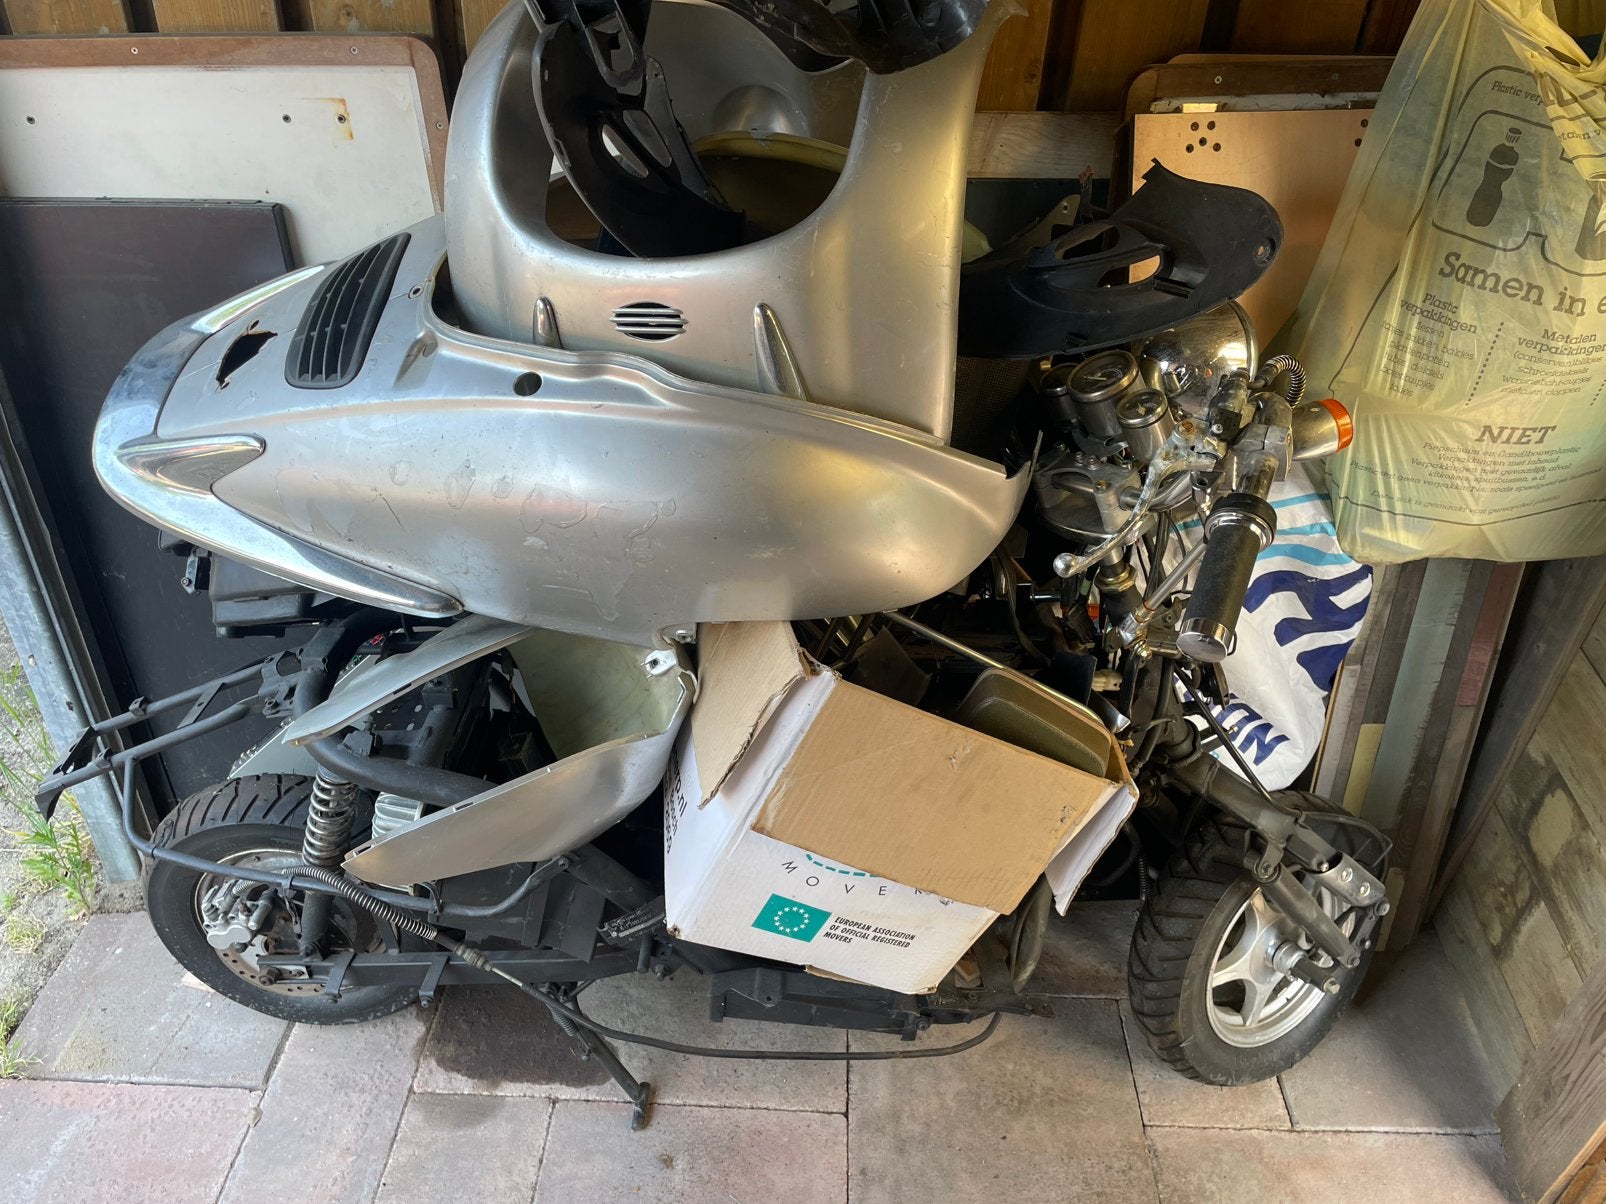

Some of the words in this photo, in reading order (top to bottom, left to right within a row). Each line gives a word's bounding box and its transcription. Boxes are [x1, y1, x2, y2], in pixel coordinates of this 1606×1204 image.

[1491, 80, 1523, 97] Plastic
[1438, 251, 1545, 307] Samen
[1552, 286, 1587, 317] in
[1422, 292, 1458, 315] Plastic
[1541, 328, 1597, 345] Metalen
[1474, 425, 1557, 446] NIET
[823, 931, 852, 944] MOVERS
[829, 924, 839, 932] OF
[840, 926, 870, 940] OFFICIAL
[870, 935, 911, 948] REGISTERED
[834, 916, 873, 932] EUROPEAN
[872, 926, 916, 941] ASSOCIATION
